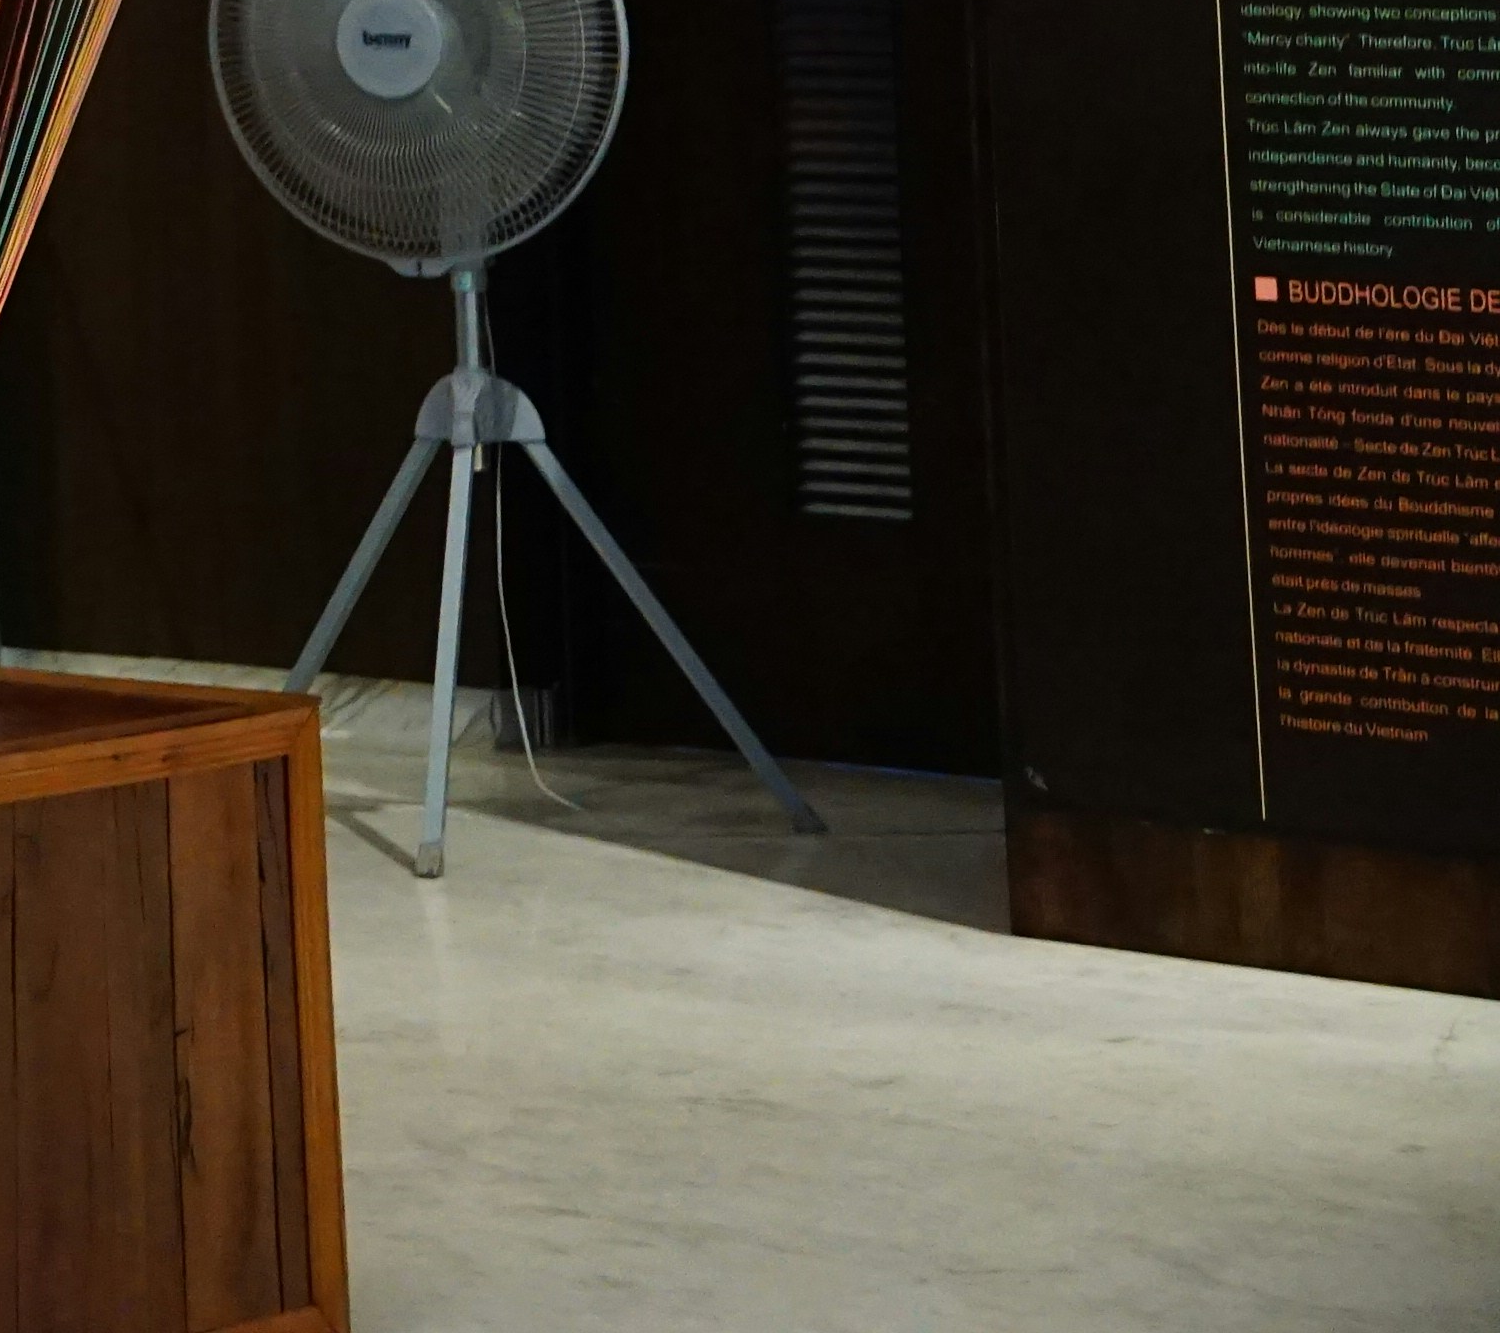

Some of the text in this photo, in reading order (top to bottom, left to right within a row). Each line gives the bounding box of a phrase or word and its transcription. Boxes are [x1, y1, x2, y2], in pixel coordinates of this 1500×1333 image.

[1309, 5, 1370, 21] showing
[1374, 7, 1400, 19] two
[1405, 7, 1496, 21] conceptions
[1308, 61, 1336, 77] Zen
[1349, 64, 1402, 78] familiar
[1415, 66, 1445, 79] with
[1245, 92, 1324, 105] connection
[1328, 93, 1342, 106] of
[1345, 93, 1367, 106] the
[1284, 121, 1316, 134] Lâm
[1322, 121, 1350, 136] Zen
[1356, 124, 1407, 140] always
[1413, 127, 1450, 142] gave
[1456, 126, 1479, 140] the
[1249, 150, 1352, 165] independence
[1356, 153, 1384, 167] and
[1250, 179, 1350, 198] strengthening
[1354, 182, 1377, 196] the
[1381, 182, 1420, 197] State
[1423, 185, 1437, 198] of
[1252, 209, 1472, 230] is considerable contribution
[1253, 236, 1340, 253] Vietnamese
[1289, 280, 1462, 312] BUDDHOLOGIE
